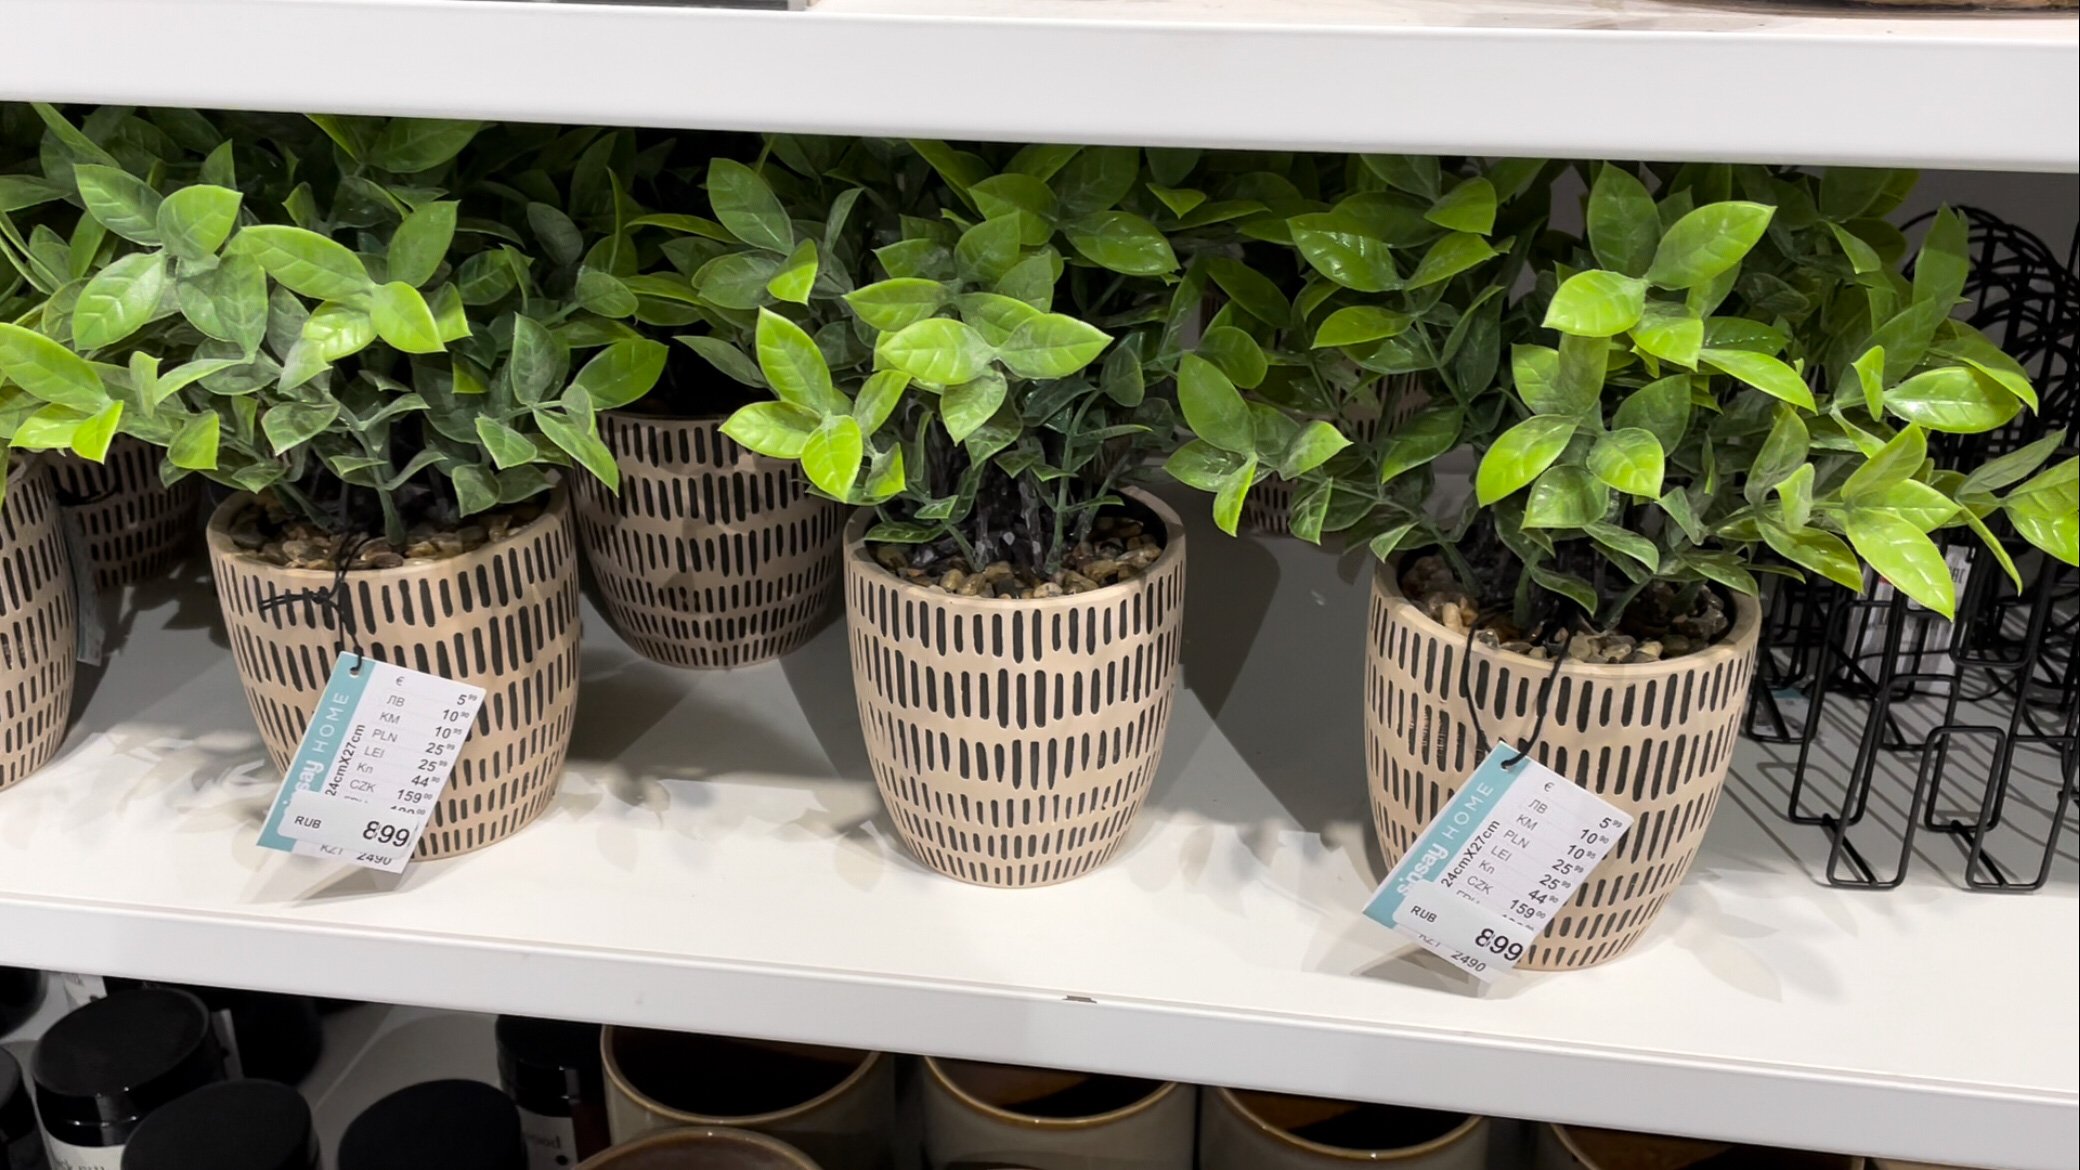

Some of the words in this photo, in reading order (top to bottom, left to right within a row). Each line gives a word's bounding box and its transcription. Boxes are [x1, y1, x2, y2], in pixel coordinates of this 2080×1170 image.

[395, 676, 404, 686] €
[312, 692, 350, 753] HOME
[379, 711, 401, 725] KM
[371, 729, 399, 743] PLN
[363, 746, 385, 759] LEI
[349, 779, 376, 794] CZK
[1544, 781, 1555, 792] €
[1441, 781, 1494, 841] HOME
[294, 815, 322, 830] RUB
[362, 820, 410, 848] 899
[1515, 814, 1539, 832] KM
[1503, 829, 1530, 850] PLN
[1490, 845, 1513, 863] LEI
[1466, 874, 1494, 896] CZK
[1410, 905, 1438, 924] RUB
[1475, 927, 1524, 962] 899
[1450, 950, 1487, 973] 2490
